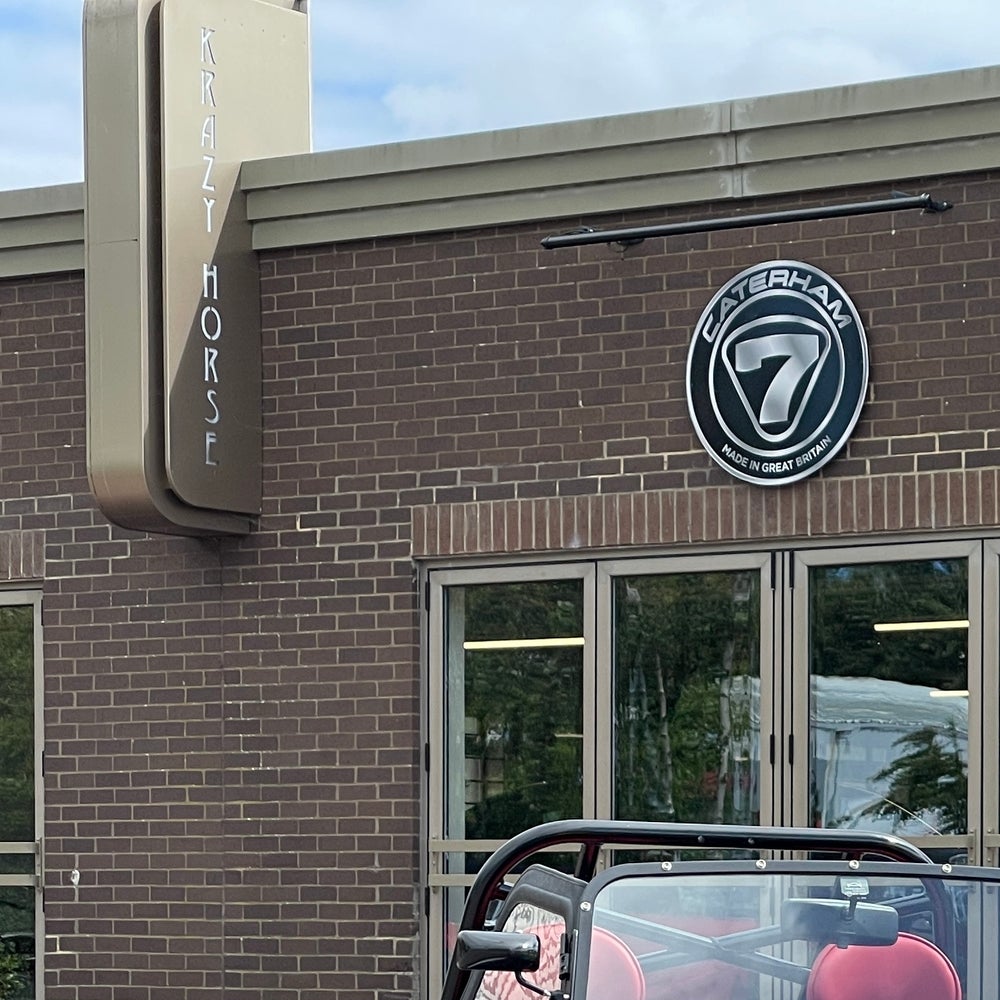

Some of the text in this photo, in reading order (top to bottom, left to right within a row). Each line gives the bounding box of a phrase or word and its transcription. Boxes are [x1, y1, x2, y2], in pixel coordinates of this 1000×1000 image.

[201, 27, 222, 466] KRAZY HORSE
[702, 269, 852, 343] CATERHAM
[735, 333, 819, 424] 7
[722, 435, 832, 473] MADE IN GREAT BRITAIN
